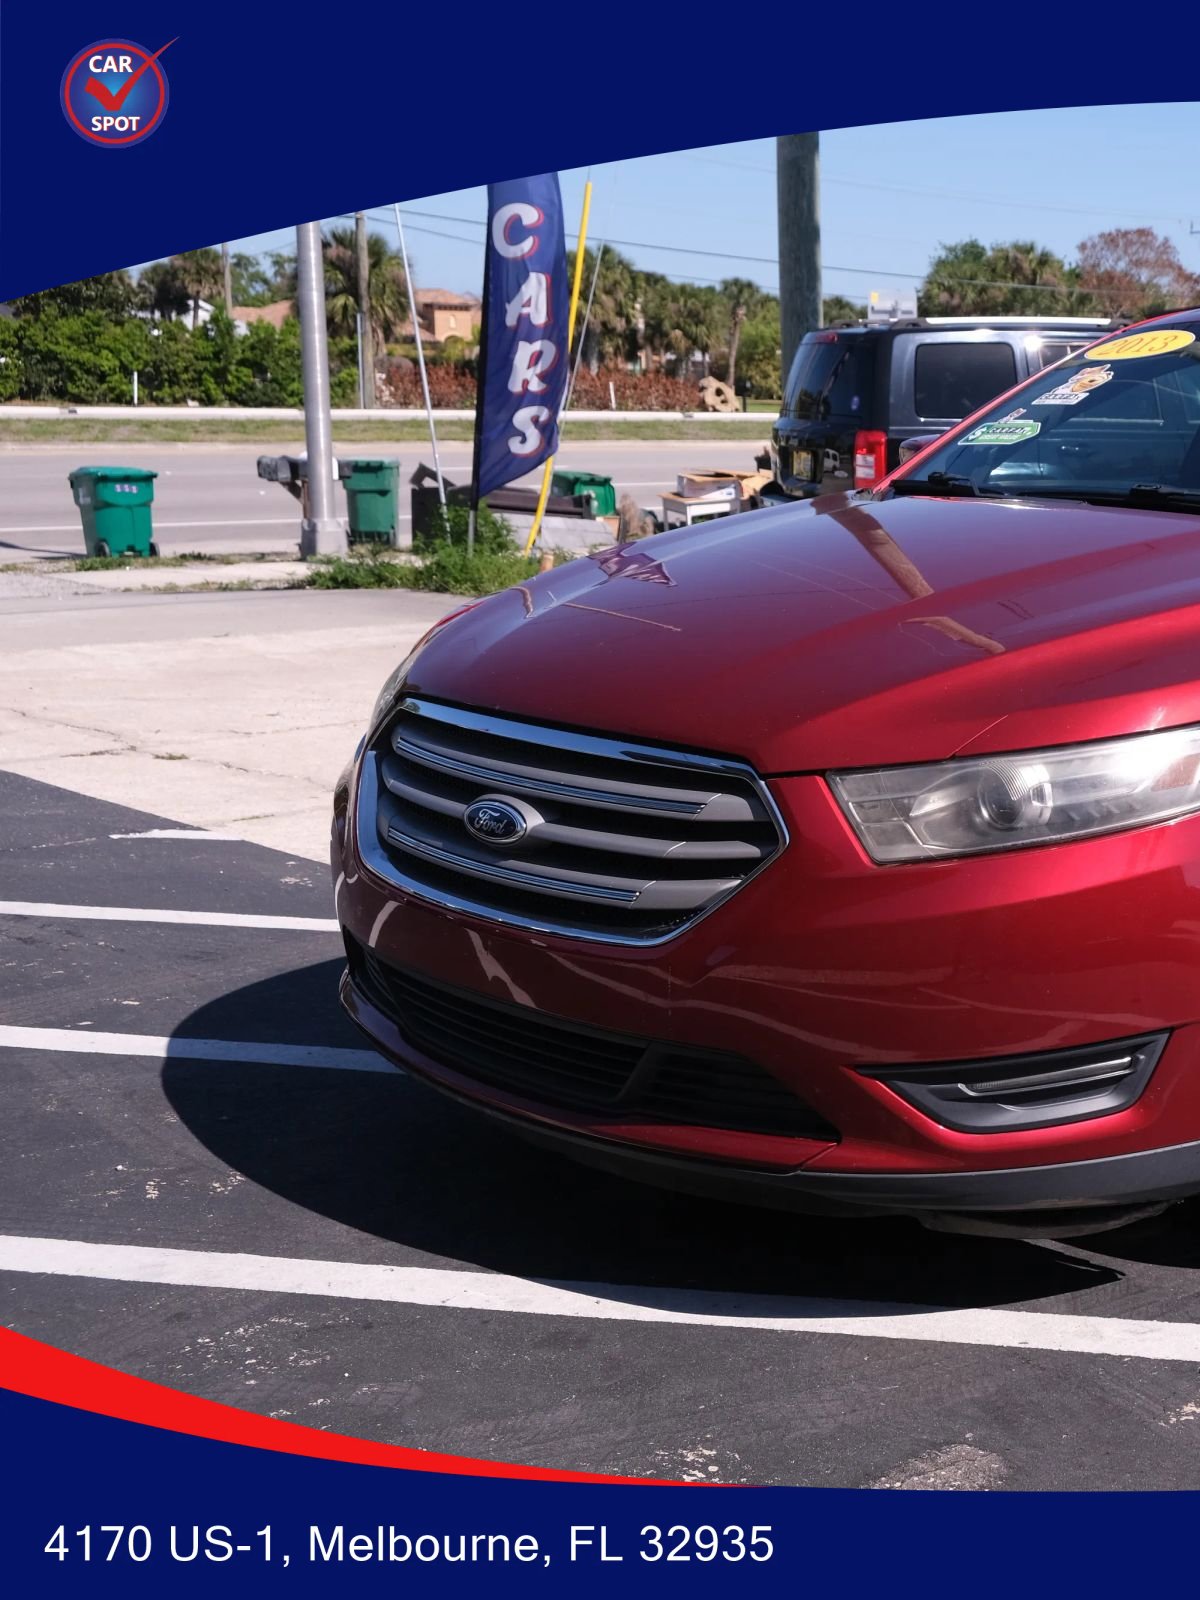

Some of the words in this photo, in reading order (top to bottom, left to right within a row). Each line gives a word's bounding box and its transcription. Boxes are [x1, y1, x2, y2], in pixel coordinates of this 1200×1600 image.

[492, 202, 558, 458] CARS
[1096, 334, 1179, 356] 2013
[474, 808, 508, 834] Ford
